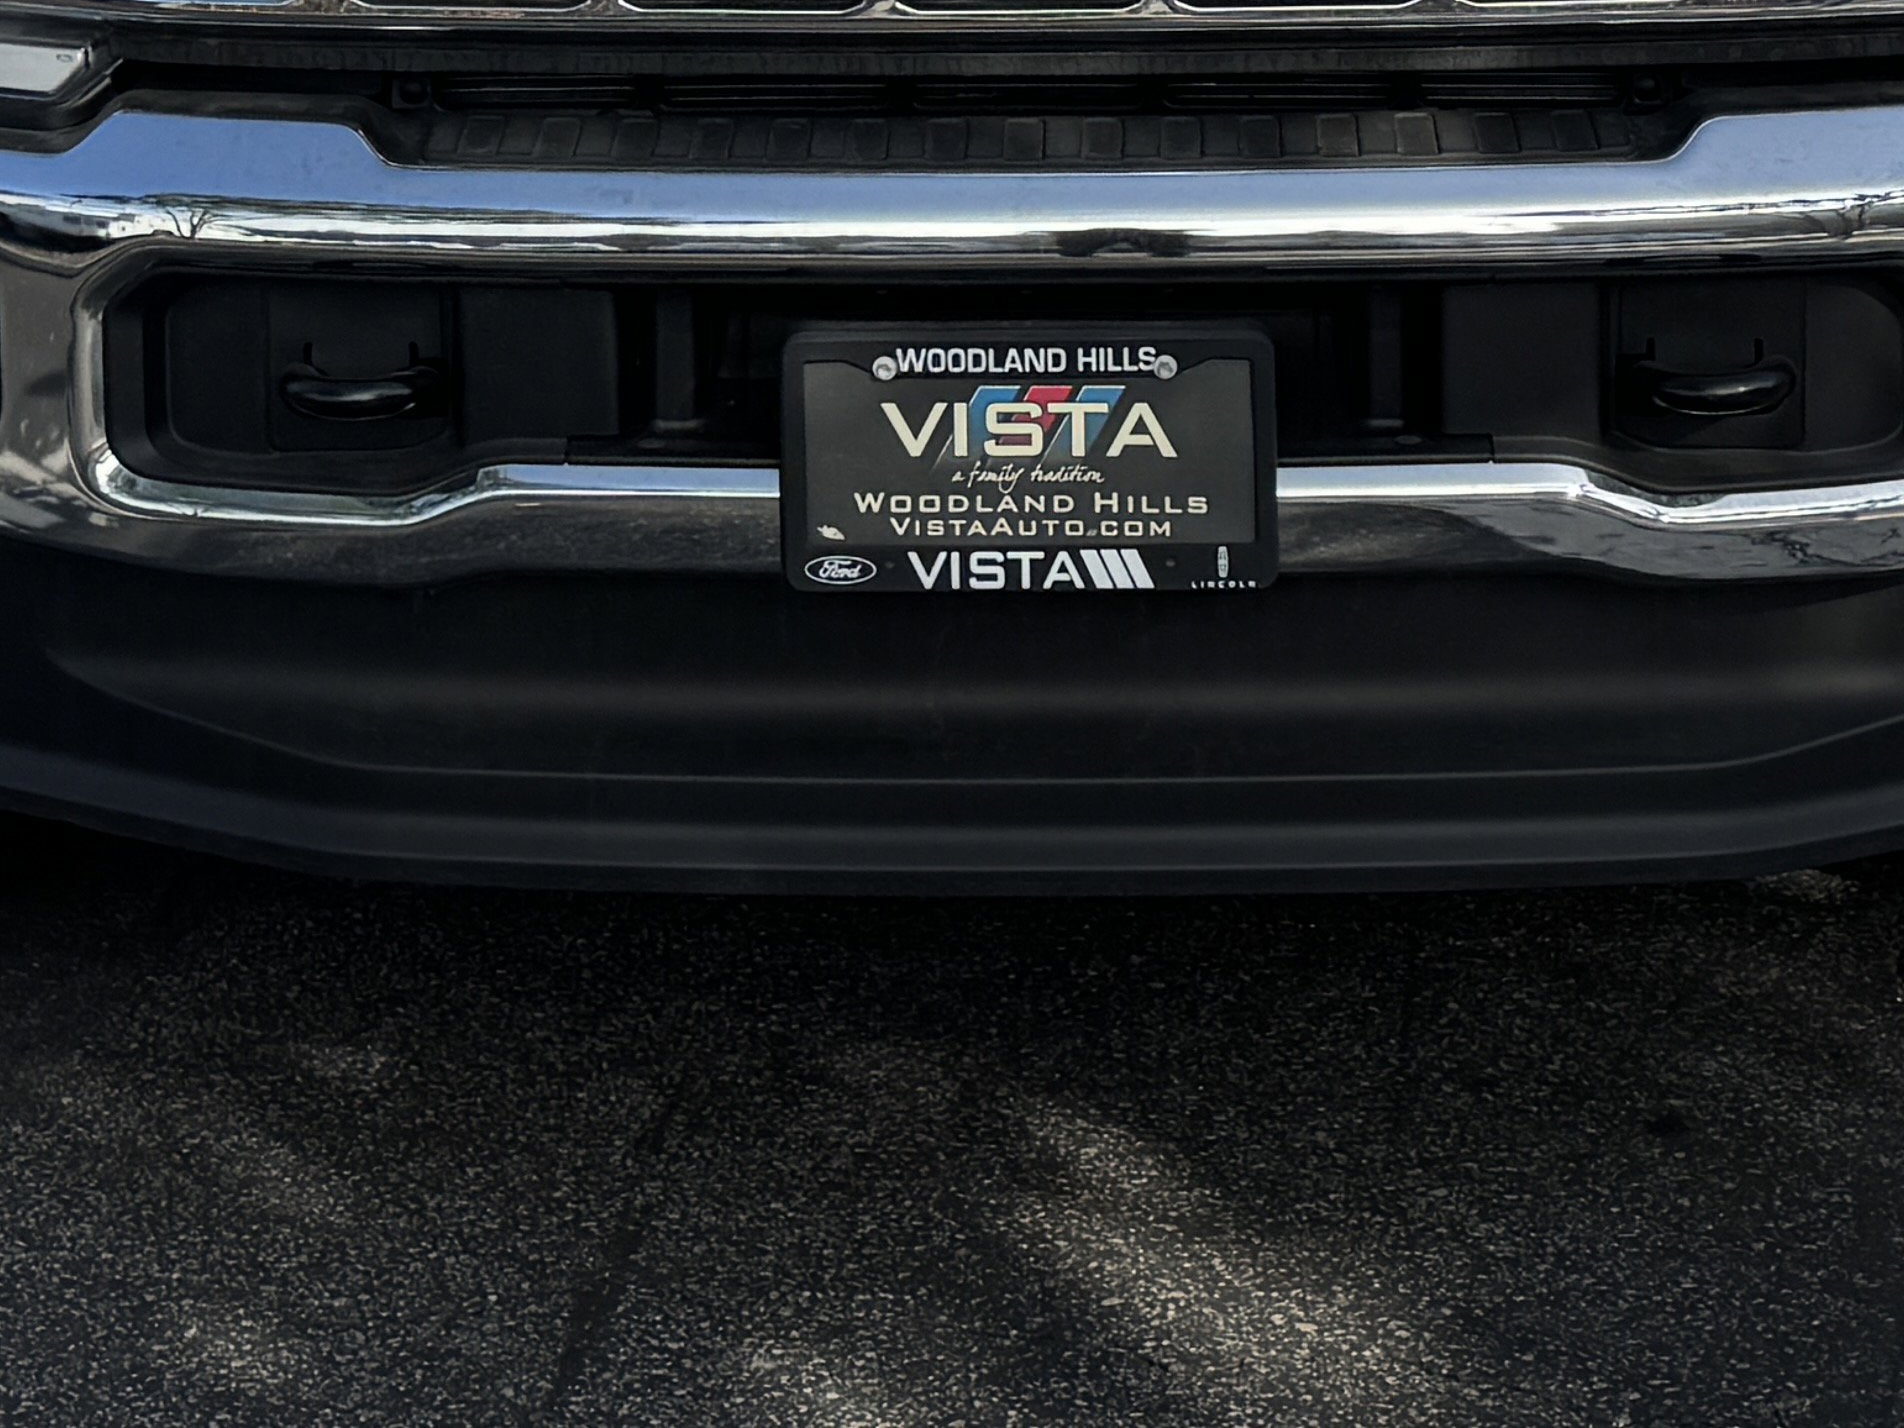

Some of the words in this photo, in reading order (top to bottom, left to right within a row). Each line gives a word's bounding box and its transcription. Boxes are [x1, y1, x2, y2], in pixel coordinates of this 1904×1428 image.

[896, 347, 1067, 375] WOODLAND
[1077, 346, 1157, 373] HILLS
[880, 402, 1179, 458] VISTA
[951, 471, 965, 482] a
[967, 460, 1025, 494] family
[1030, 463, 1106, 484] tradition
[853, 492, 1075, 514] WOODLAND
[1093, 492, 1209, 515] HILLS
[818, 560, 862, 579] Ford
[907, 550, 1086, 590] VISTA
